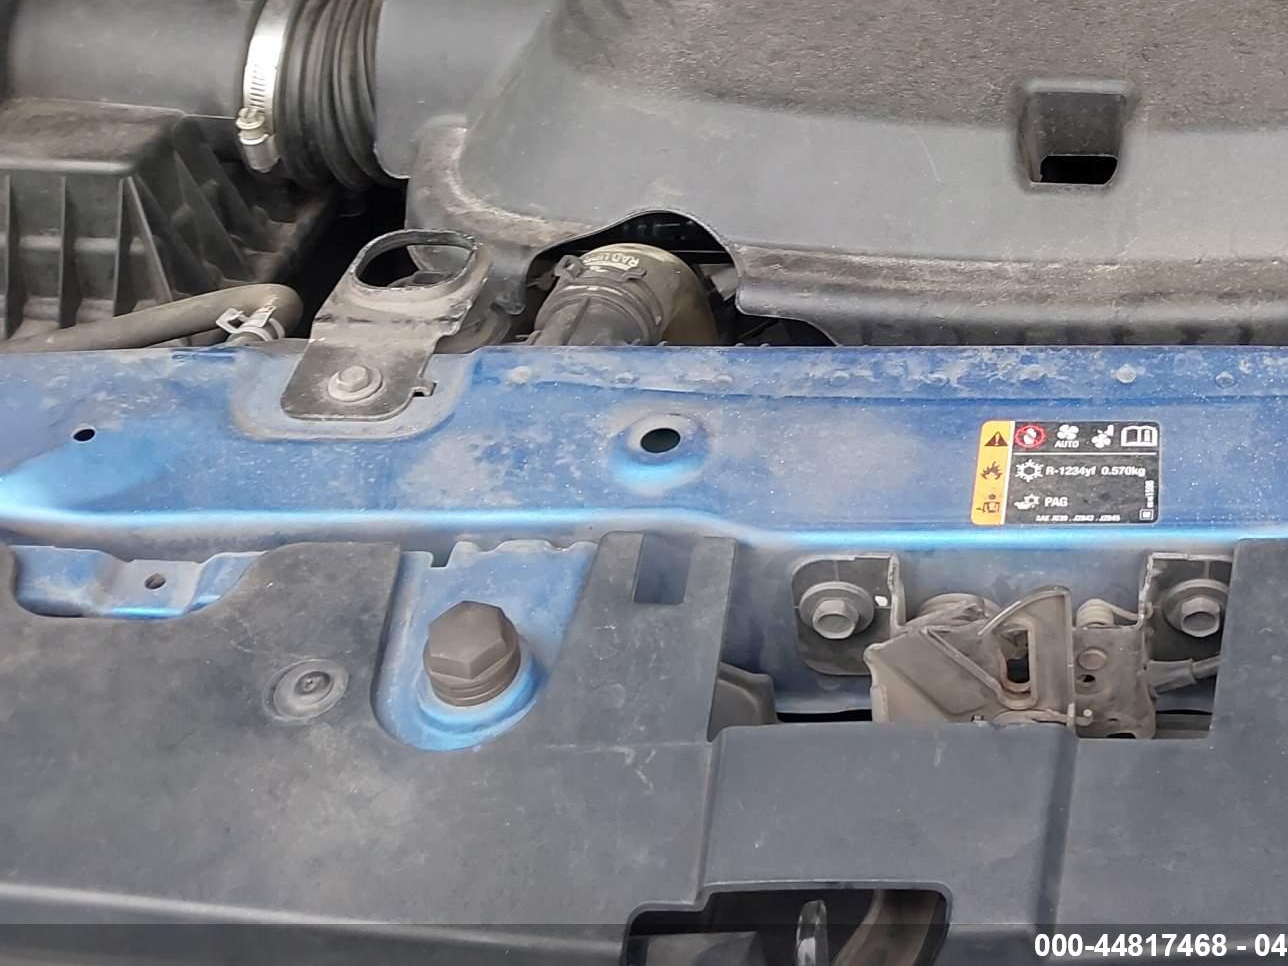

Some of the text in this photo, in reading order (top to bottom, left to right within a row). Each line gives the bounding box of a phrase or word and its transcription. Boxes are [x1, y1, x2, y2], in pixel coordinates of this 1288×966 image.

[1054, 440, 1080, 448] AUTO
[1045, 465, 1146, 477] R-1234yf 0.570kg
[1044, 496, 1069, 507] PAG
